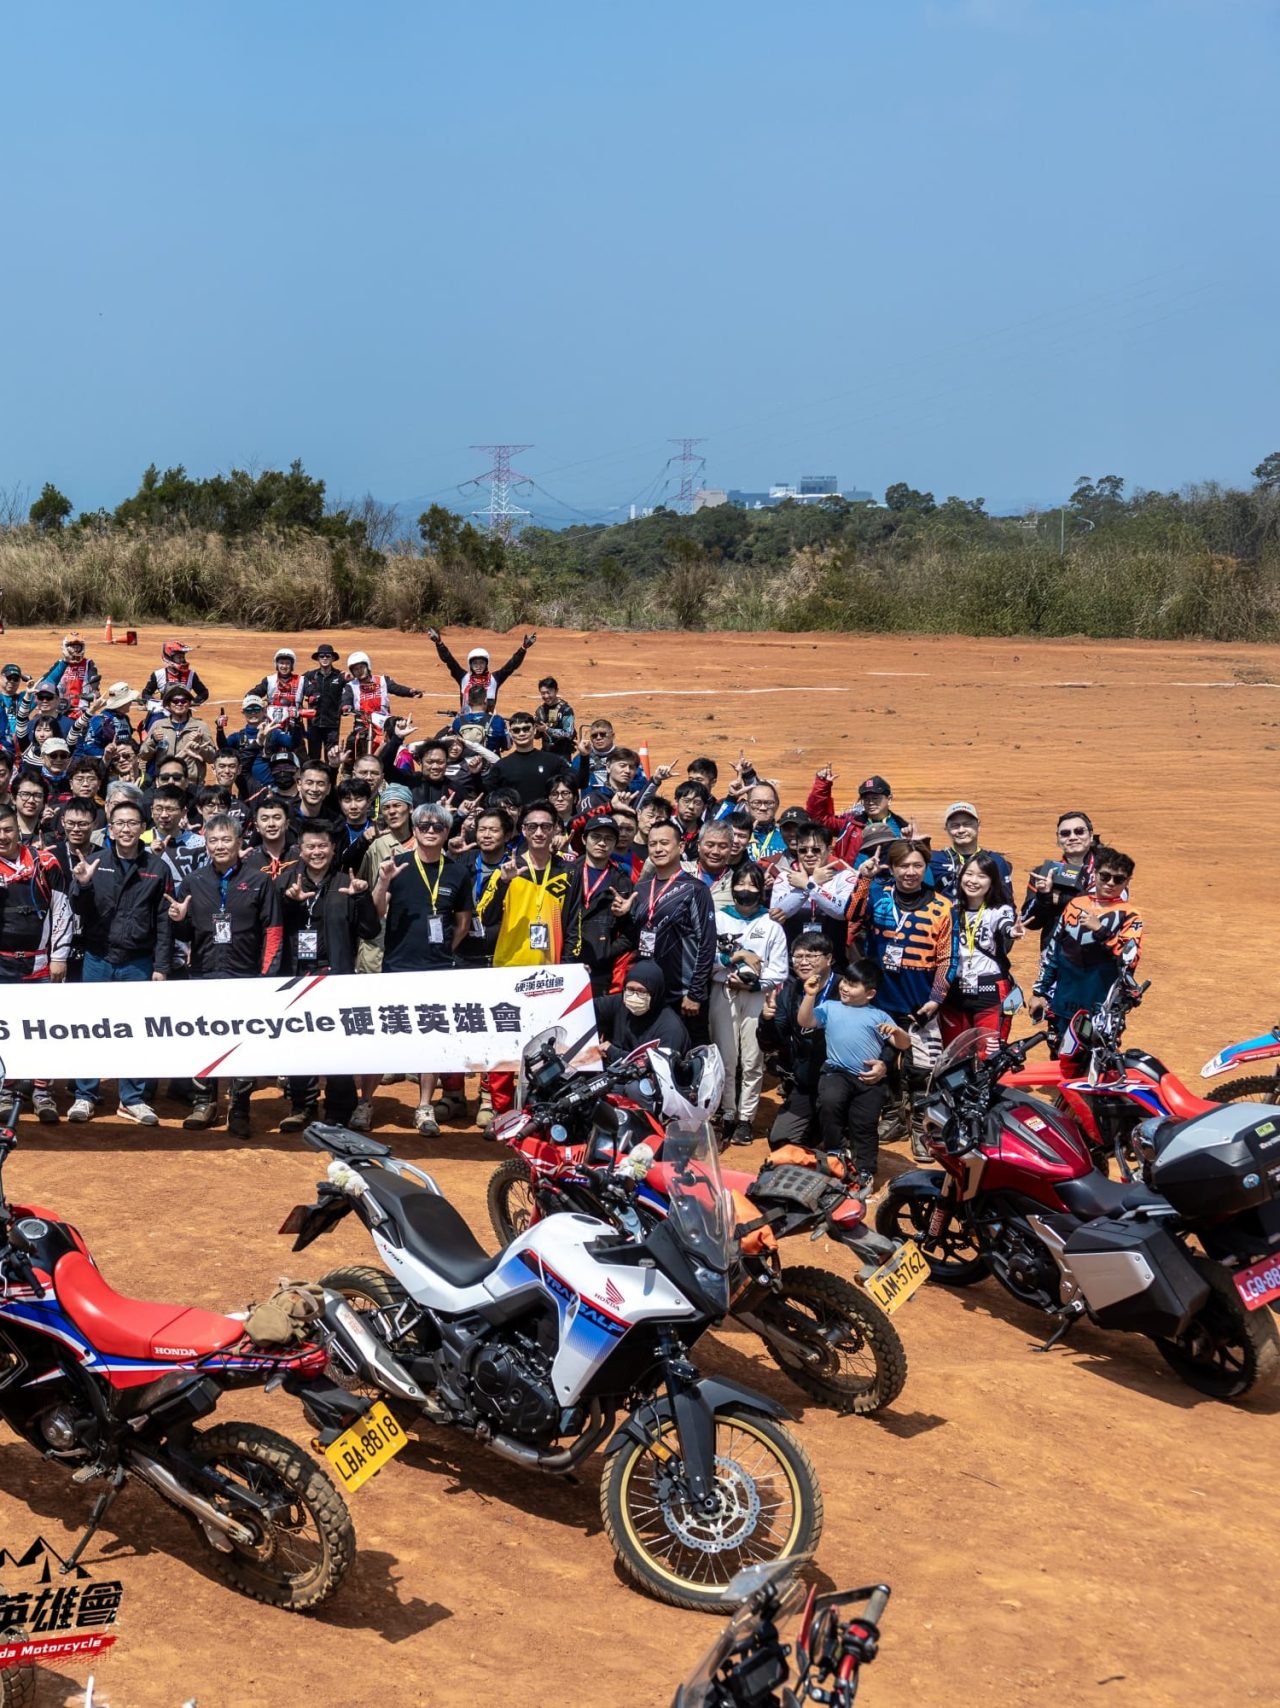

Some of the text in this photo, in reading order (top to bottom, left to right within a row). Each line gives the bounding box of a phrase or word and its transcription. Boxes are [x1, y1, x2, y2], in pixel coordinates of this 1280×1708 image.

[22, 1017, 133, 1041] Honda
[145, 1011, 336, 1040] Motorcycle
[340, 1002, 522, 1037] 硬漢英雄會
[874, 1252, 926, 1306] LAM-5762
[1239, 1264, 1280, 1301] LGQ-88
[594, 1292, 620, 1311] HONDA
[154, 1347, 198, 1357] HONDA
[335, 1416, 399, 1481] LBA-8818
